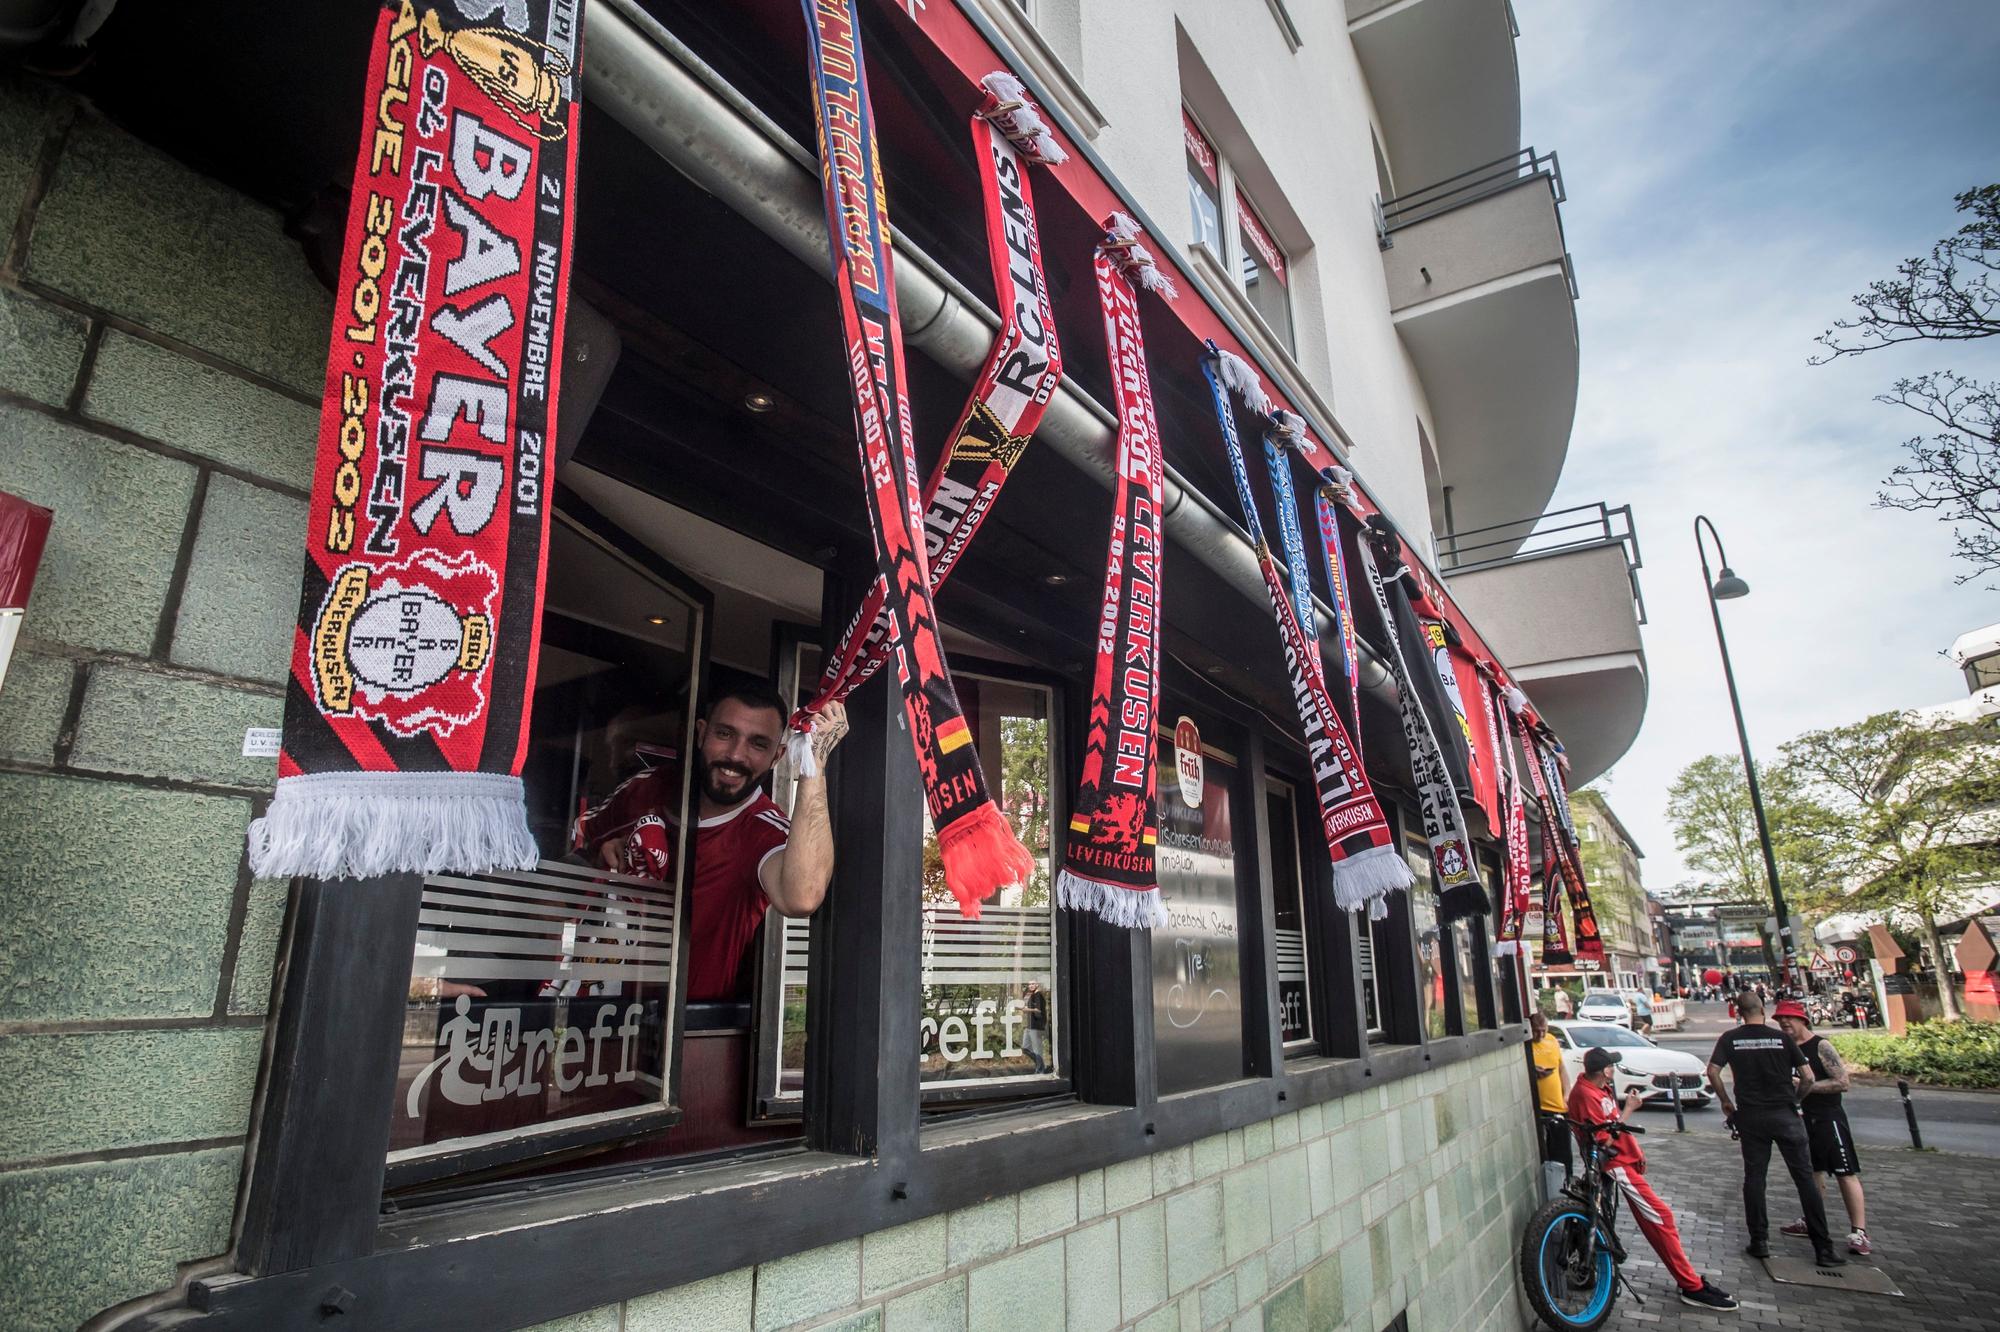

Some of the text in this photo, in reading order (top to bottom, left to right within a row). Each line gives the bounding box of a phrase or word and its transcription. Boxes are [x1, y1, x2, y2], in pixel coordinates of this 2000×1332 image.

[498, 48, 520, 88] VS
[992, 147, 1036, 293] LENS
[364, 64, 450, 555] 04 LEVERKUSEN
[409, 107, 533, 537] BAYER
[515, 177, 561, 516] 21 NOVEMBRE 2001
[930, 481, 1000, 594] VERKUSEN
[322, 575, 365, 702] LEVERKUSEN
[351, 634, 459, 653] BAYER
[393, 601, 422, 683] BAYER
[465, 620, 487, 668] 1904
[1112, 495, 1155, 788] LEVERKUSEN
[1180, 752, 1201, 783] früh
[1413, 757, 1441, 839] BAYER
[1067, 841, 1154, 873] LEVERKUSEN
[1518, 819, 1531, 896] Bayer 04
[481, 1003, 644, 1101] Treff
